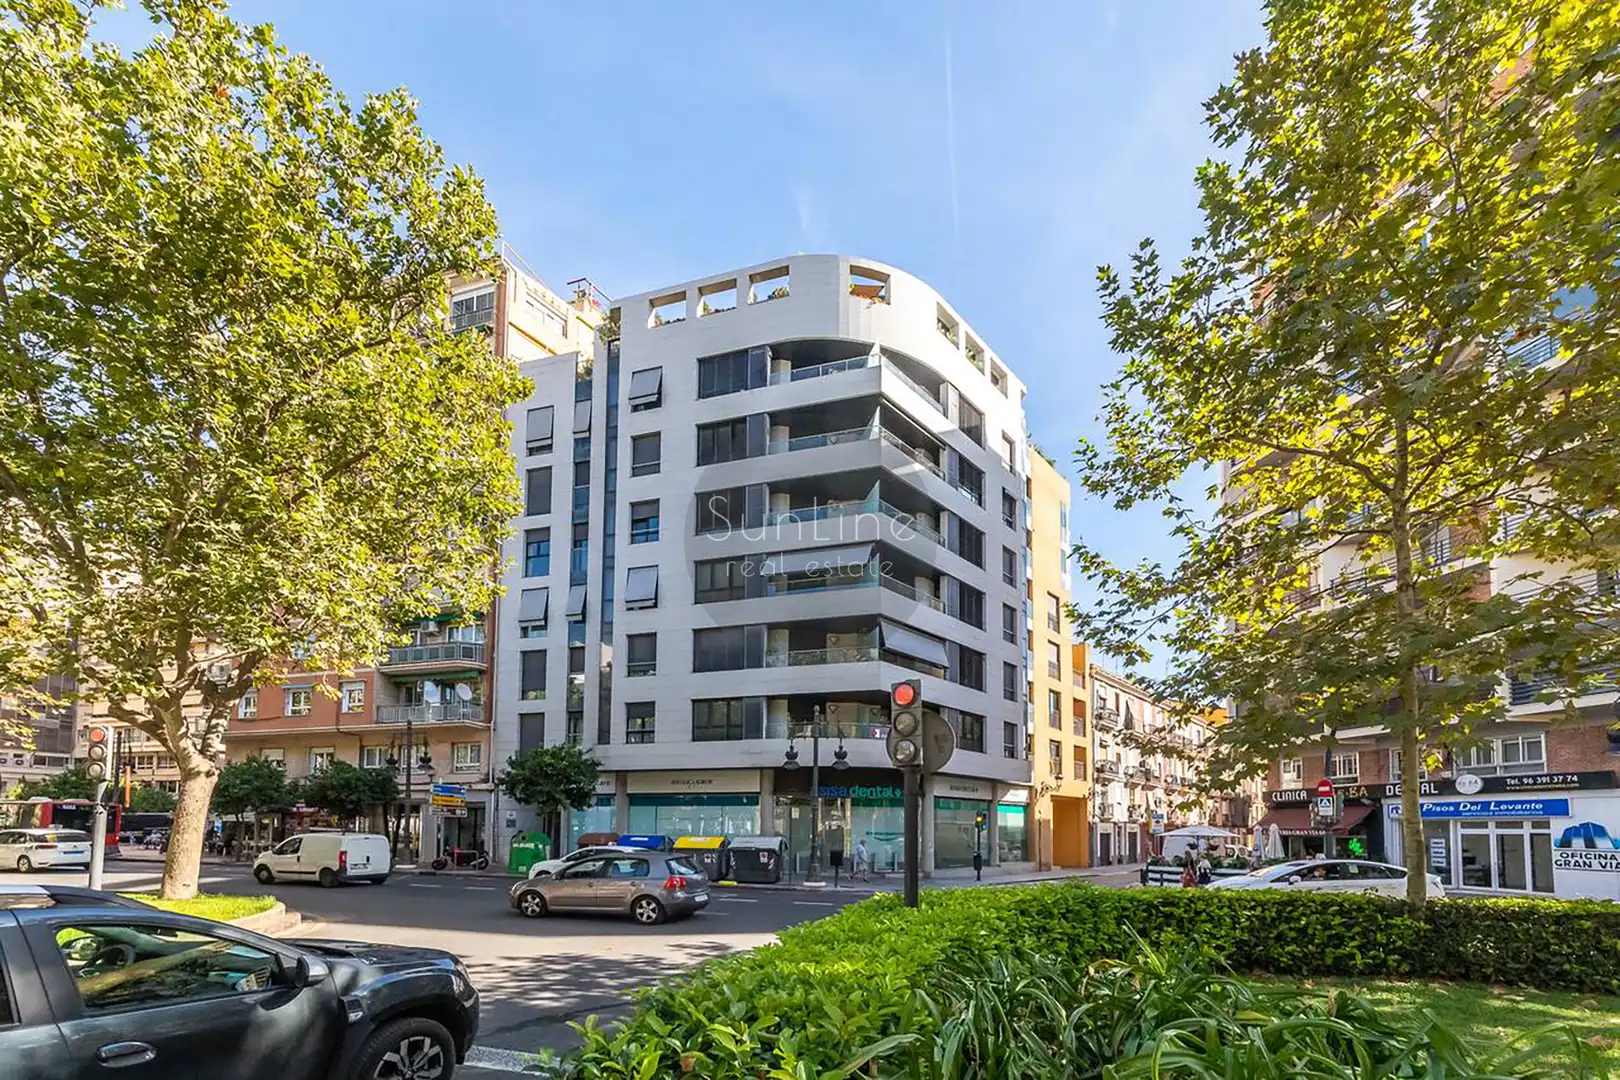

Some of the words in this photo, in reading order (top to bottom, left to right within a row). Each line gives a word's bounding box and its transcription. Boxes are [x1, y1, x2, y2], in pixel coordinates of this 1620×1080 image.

[1386, 782, 1439, 796] DEAL
[1272, 790, 1307, 802] CLINICA
[1422, 803, 1454, 812] Pisos
[1459, 802, 1481, 812] Del
[1489, 801, 1544, 811] Levante
[1559, 851, 1619, 862] OFICINA
[1554, 859, 1593, 869] GRAN
